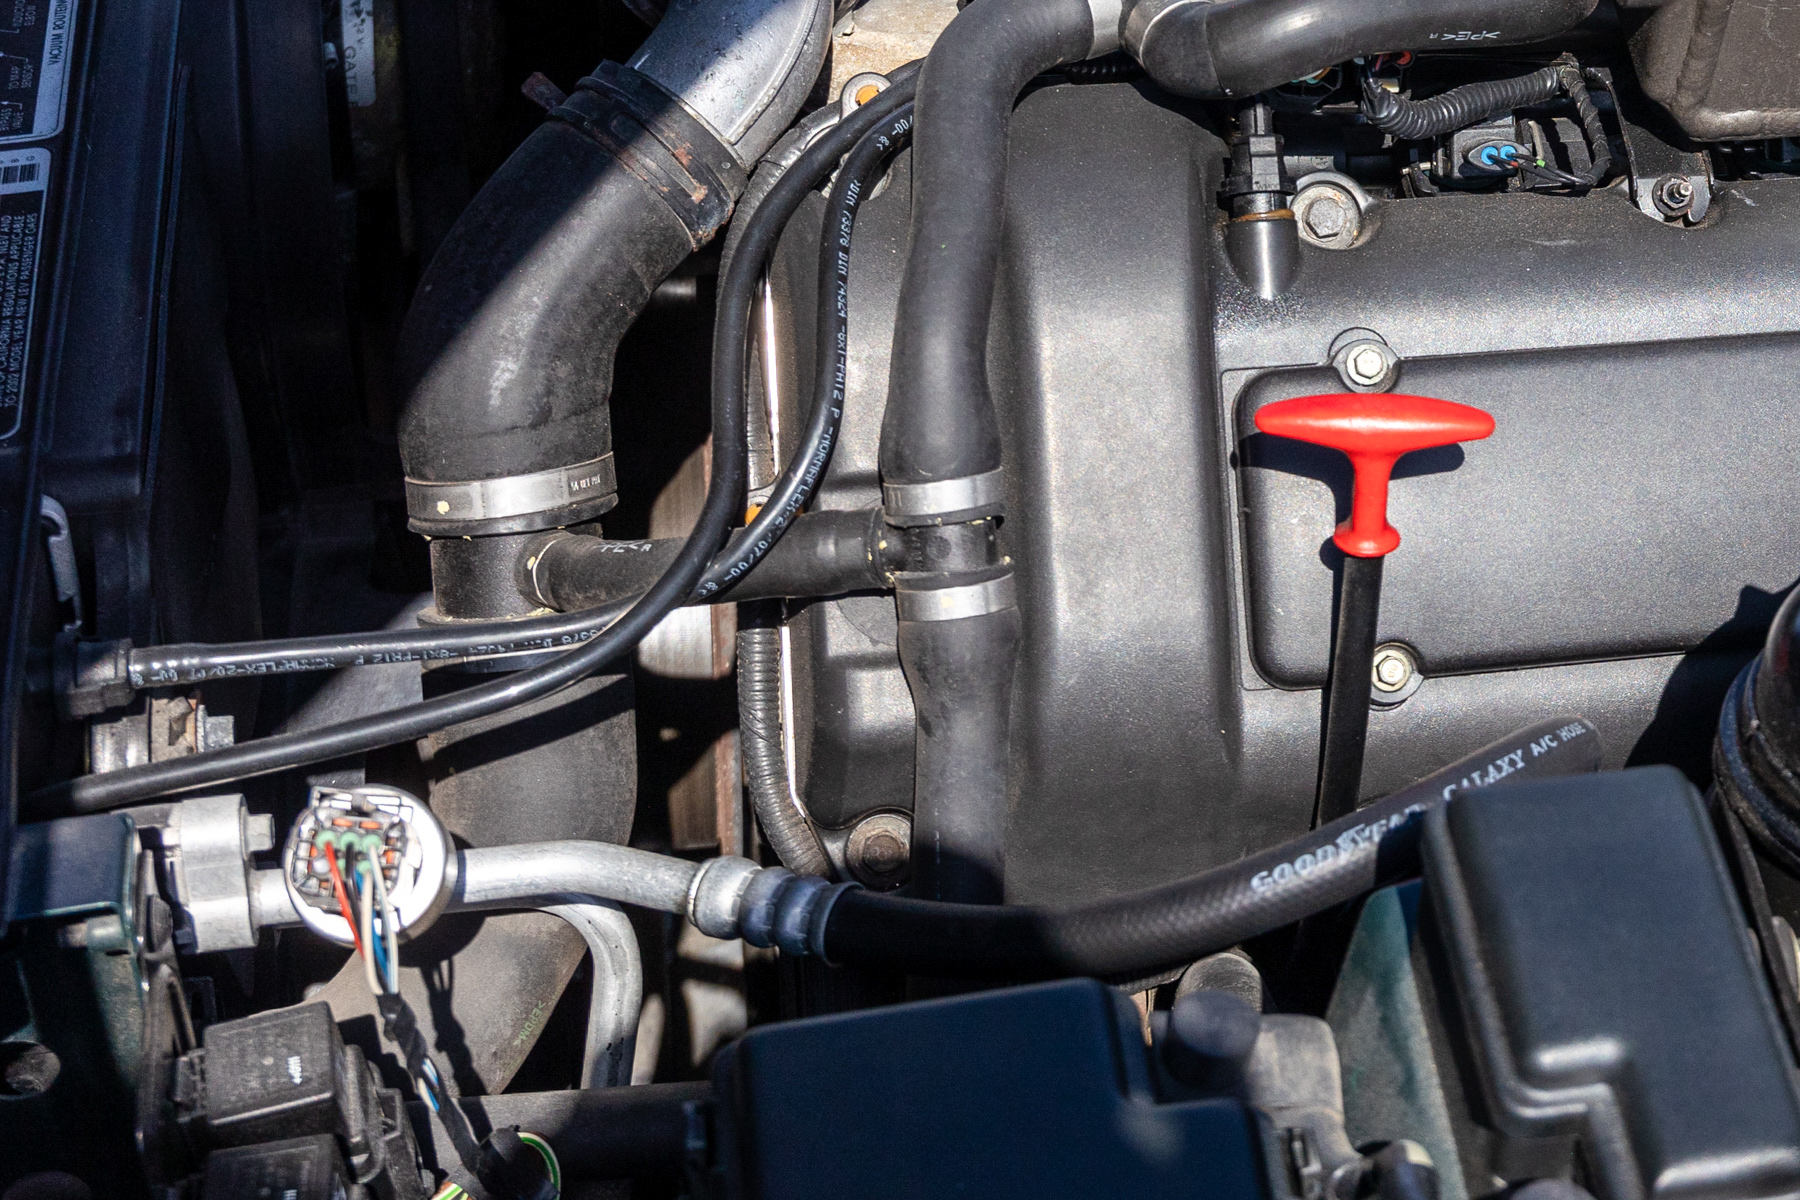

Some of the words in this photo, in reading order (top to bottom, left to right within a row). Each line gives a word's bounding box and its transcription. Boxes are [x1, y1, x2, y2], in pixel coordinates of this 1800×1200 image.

[48, 33, 64, 66] VACUUM
[20, 236, 36, 280] PASSENGER
[12, 319, 25, 340] YEAR
[9, 342, 23, 371] MODEL
